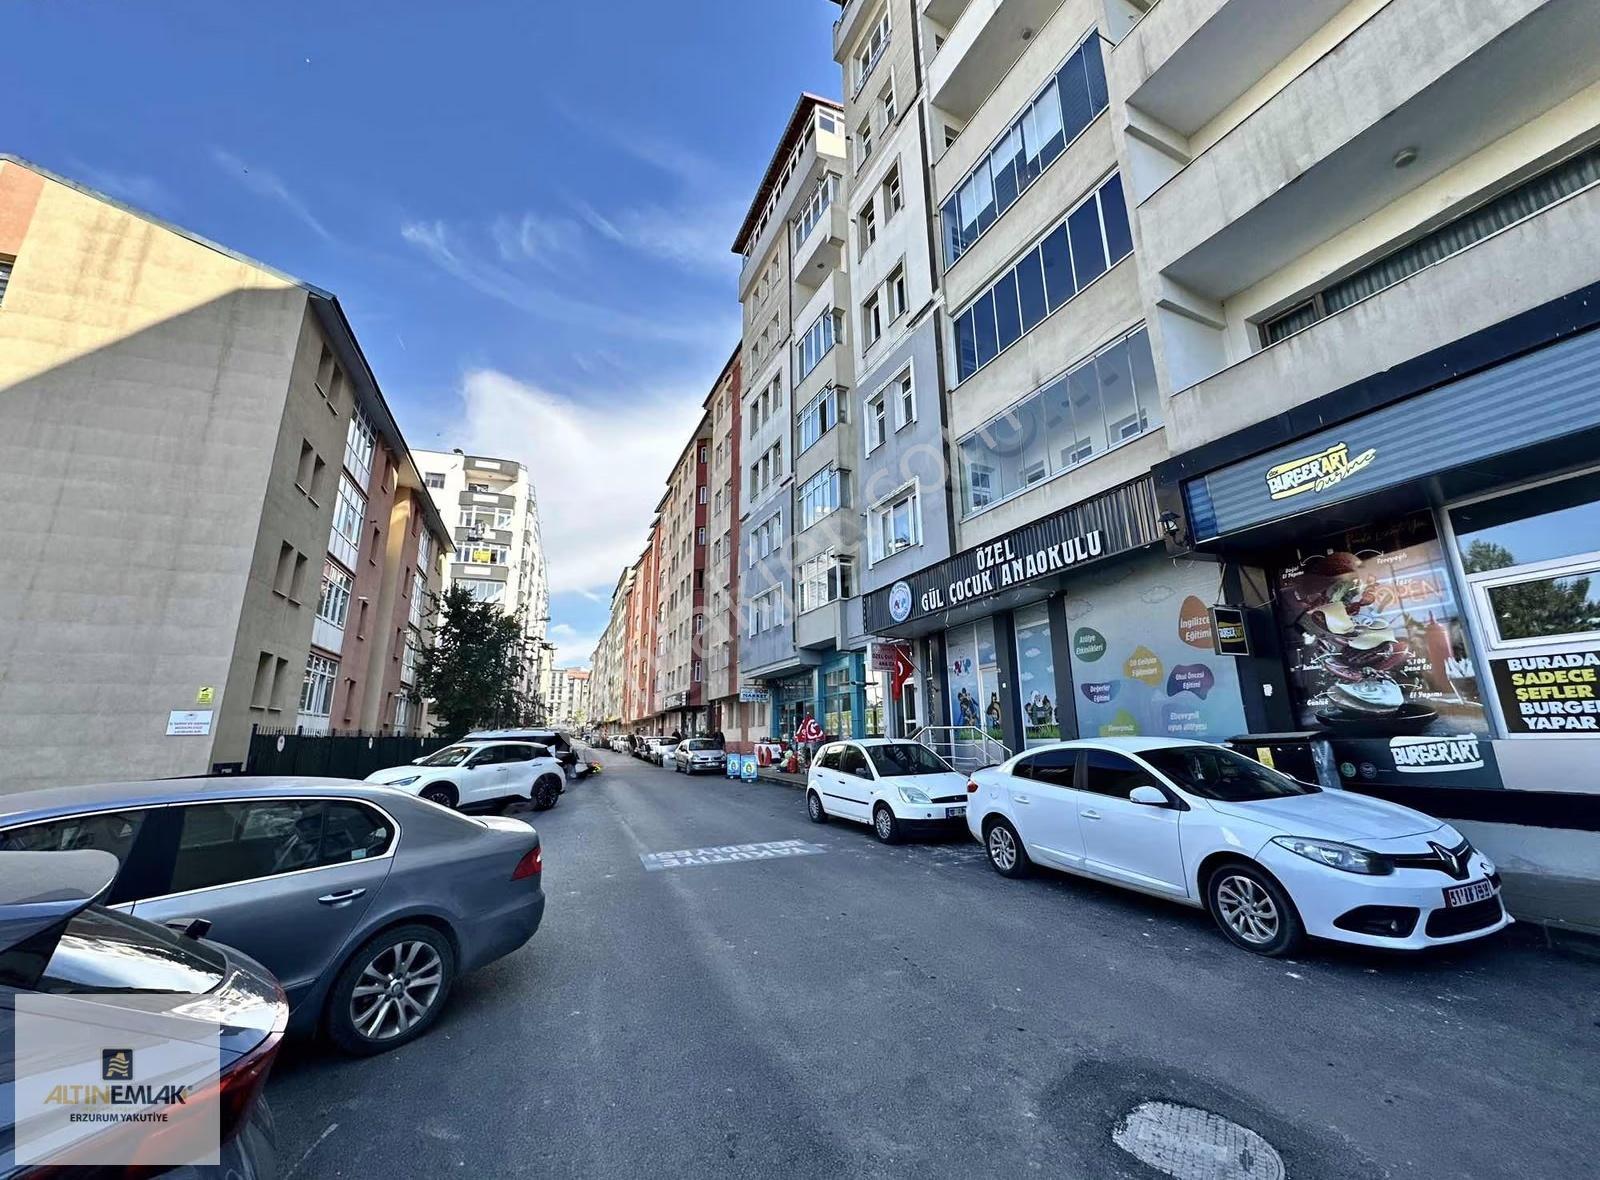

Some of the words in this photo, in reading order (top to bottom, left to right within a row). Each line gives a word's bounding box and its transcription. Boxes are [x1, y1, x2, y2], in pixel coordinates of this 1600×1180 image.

[976, 539, 1015, 571] ÖZEL
[921, 591, 944, 612] GÜL
[949, 571, 994, 605] ÇOCUK
[1001, 529, 1102, 586] ANAOKULU
[1507, 652, 1600, 672] BURADA
[1511, 668, 1597, 686] SADECE
[1515, 684, 1595, 702] ŞEFLER
[1521, 716, 1600, 730] YAPAR
